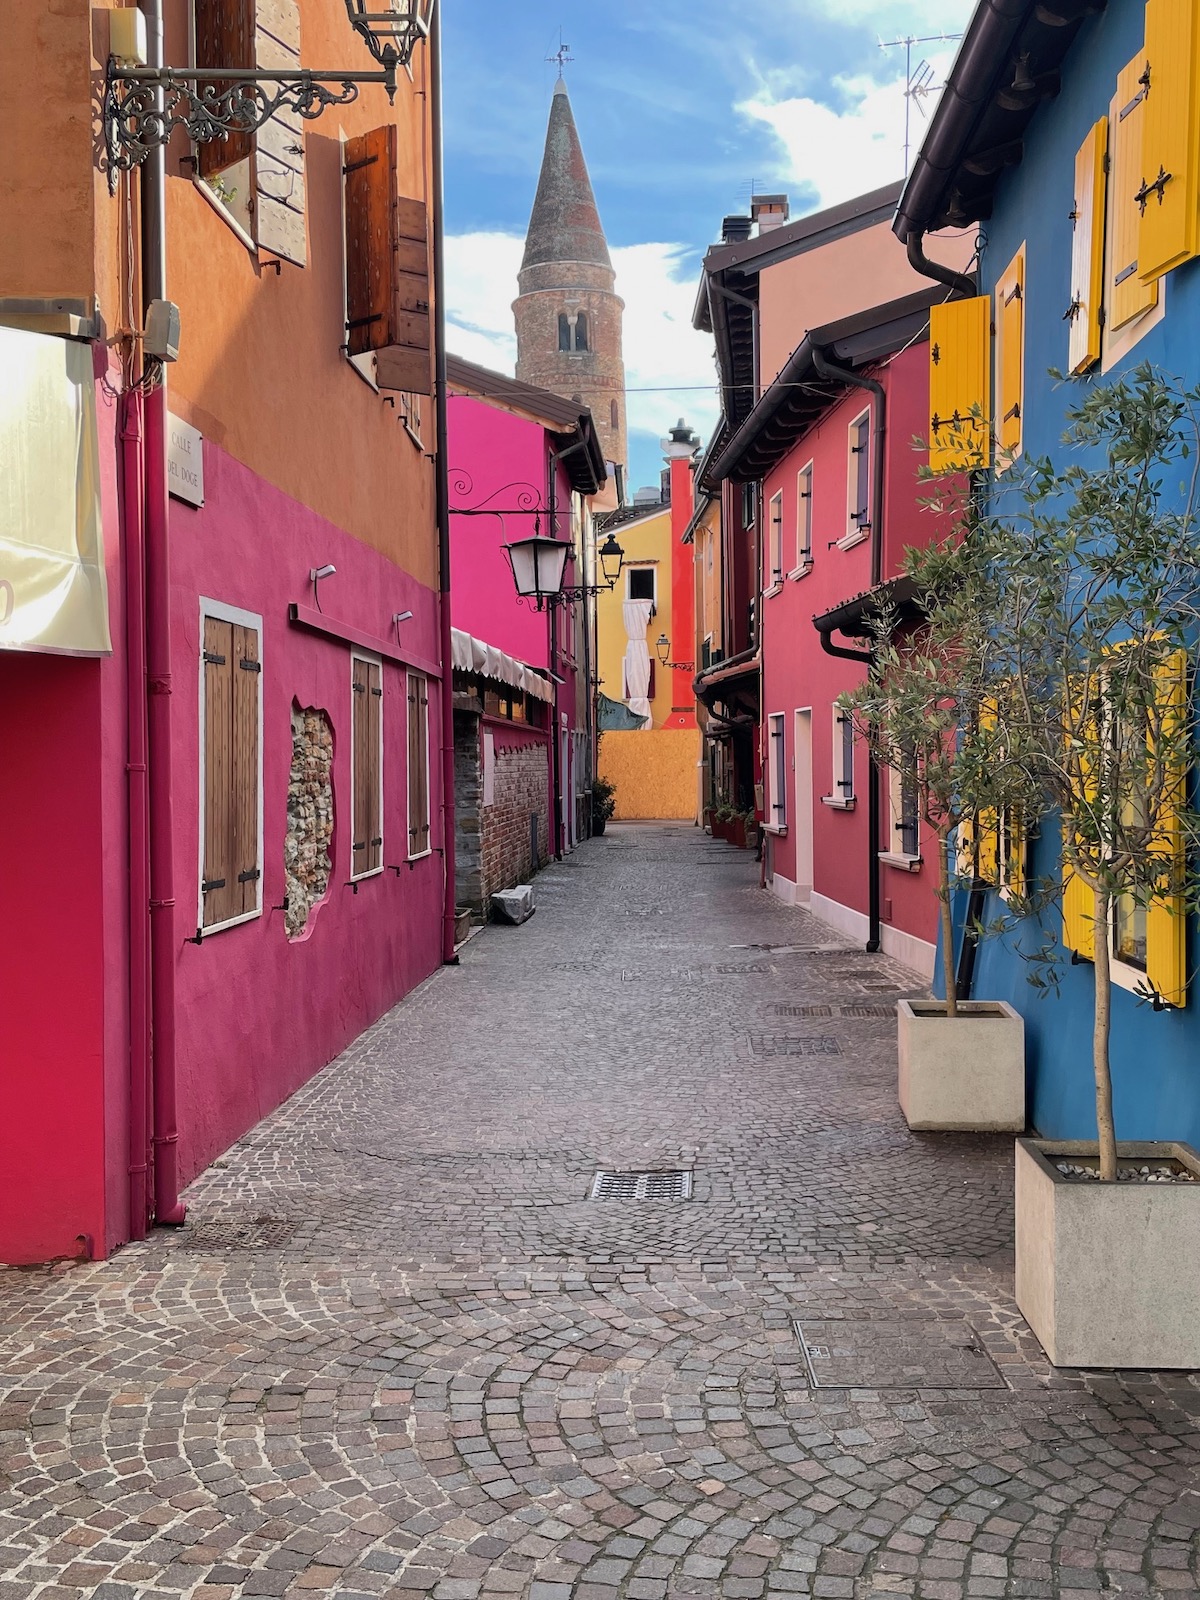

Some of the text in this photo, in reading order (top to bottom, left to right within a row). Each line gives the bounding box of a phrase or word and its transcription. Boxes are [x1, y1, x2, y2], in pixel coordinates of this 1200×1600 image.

[172, 431, 191, 455] CALLE
[168, 459, 198, 487] DEL DOGE
